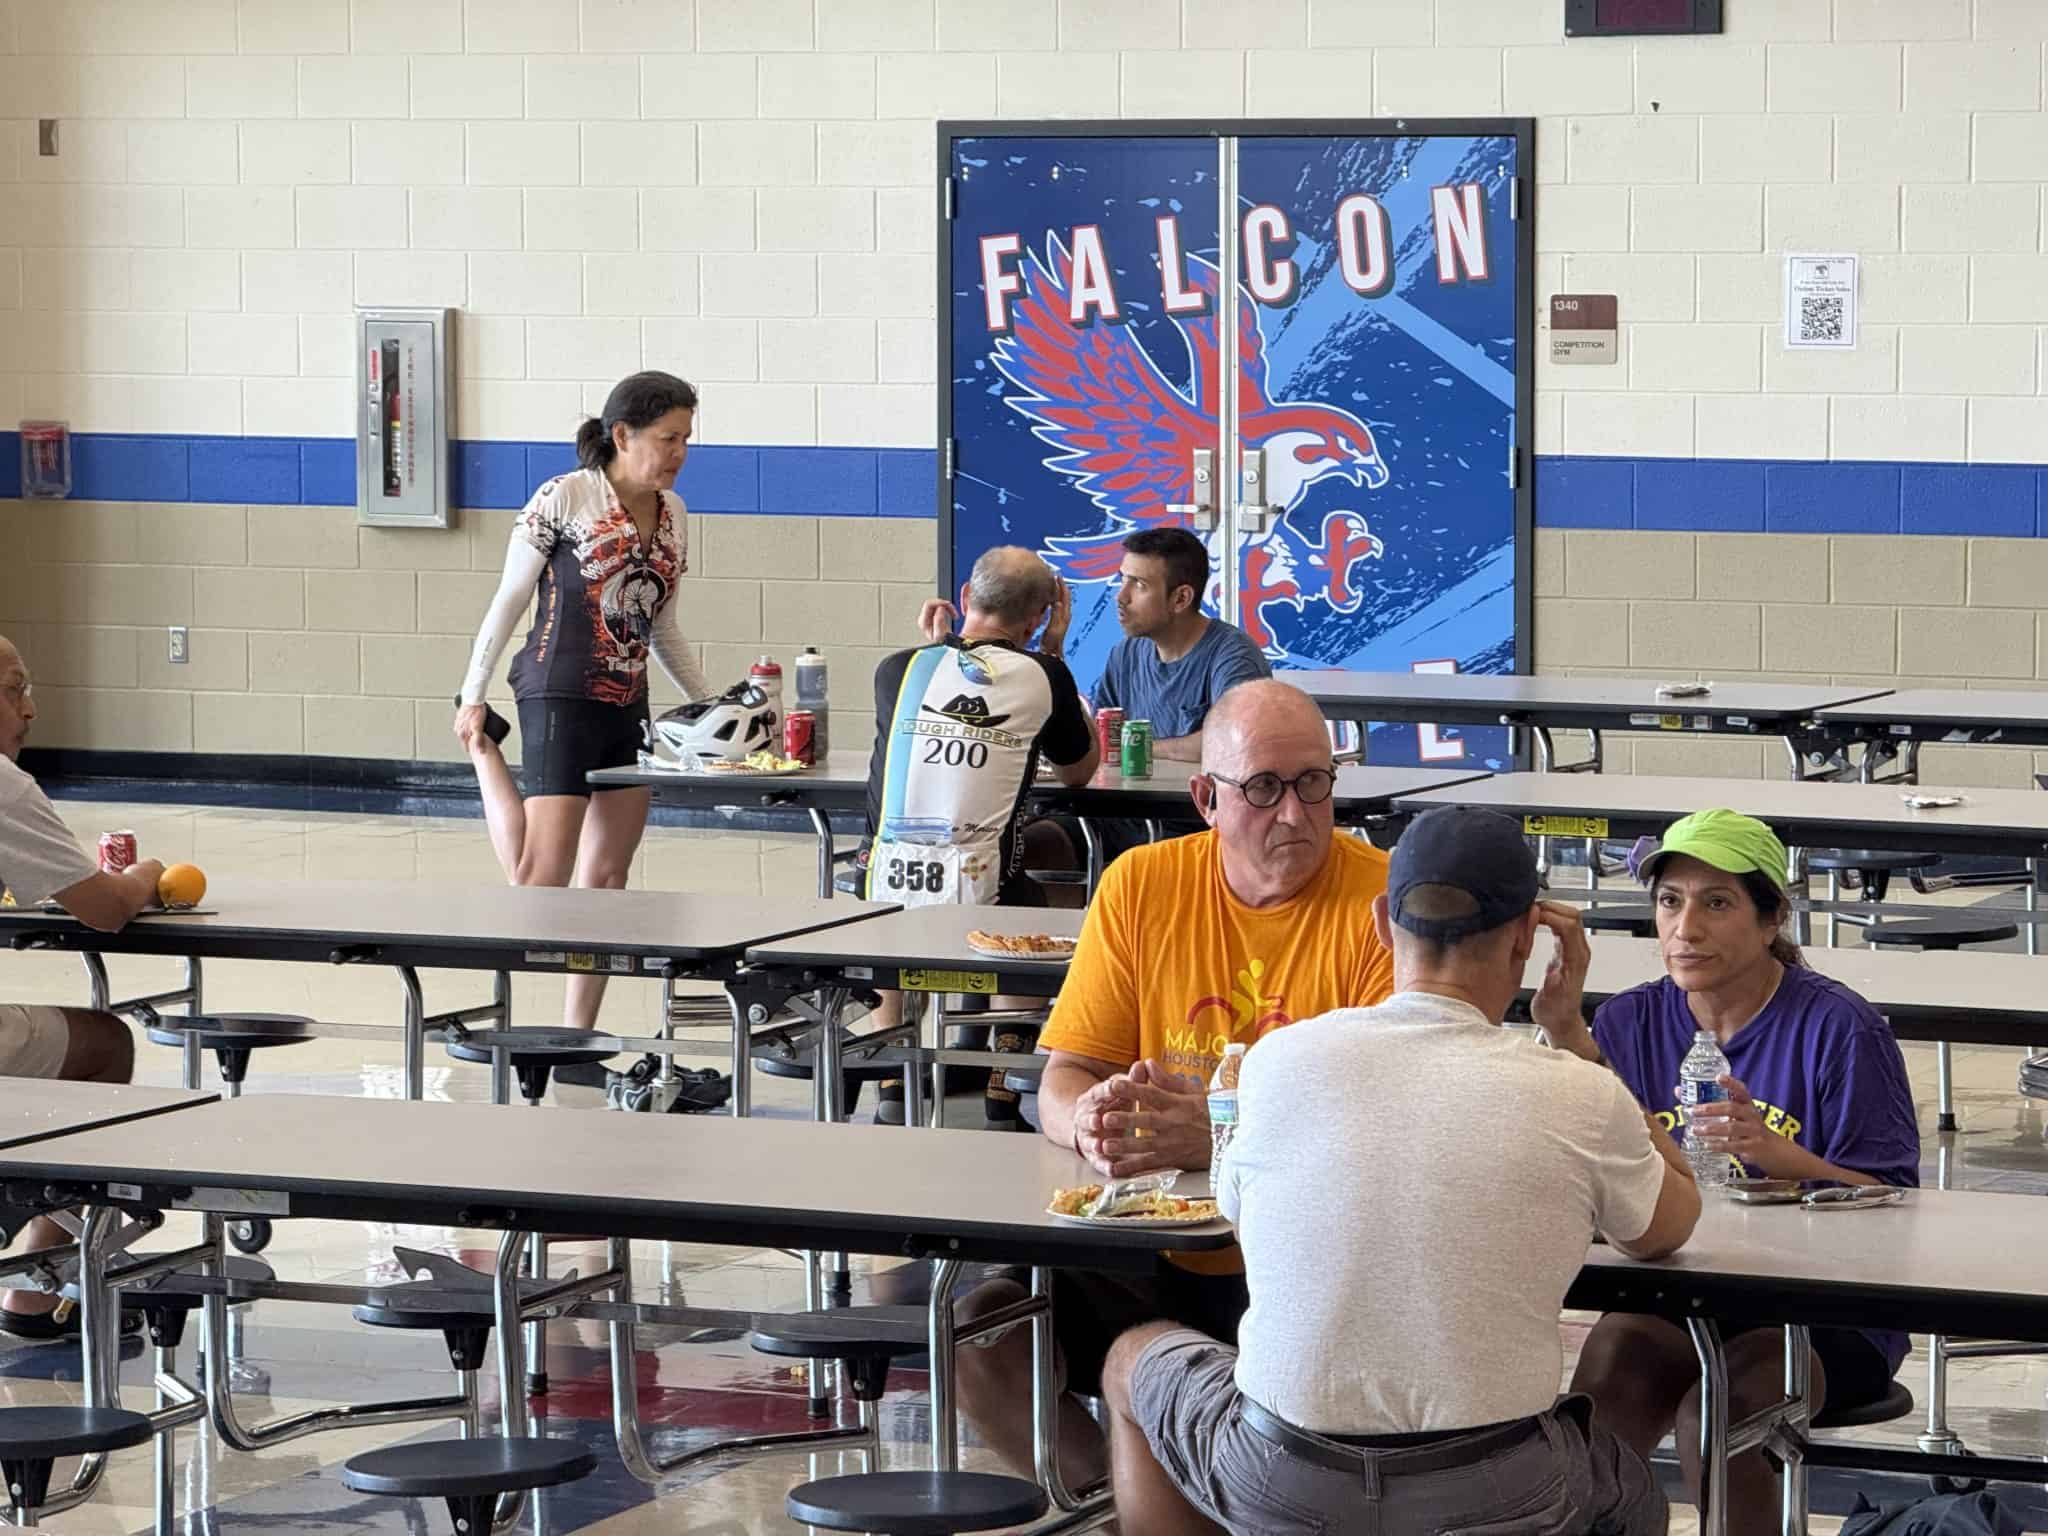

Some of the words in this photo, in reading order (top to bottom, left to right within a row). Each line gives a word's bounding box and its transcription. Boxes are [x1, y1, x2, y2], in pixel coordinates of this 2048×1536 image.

[979, 182, 1488, 332] FALCON
[1553, 300, 1579, 311] 1340
[1553, 341, 1605, 349] COMPETITION
[923, 738, 989, 768] 200
[888, 858, 945, 893] 358
[1166, 1027, 1229, 1057] MAJO
[1162, 1051, 1221, 1071] HOUSTO
